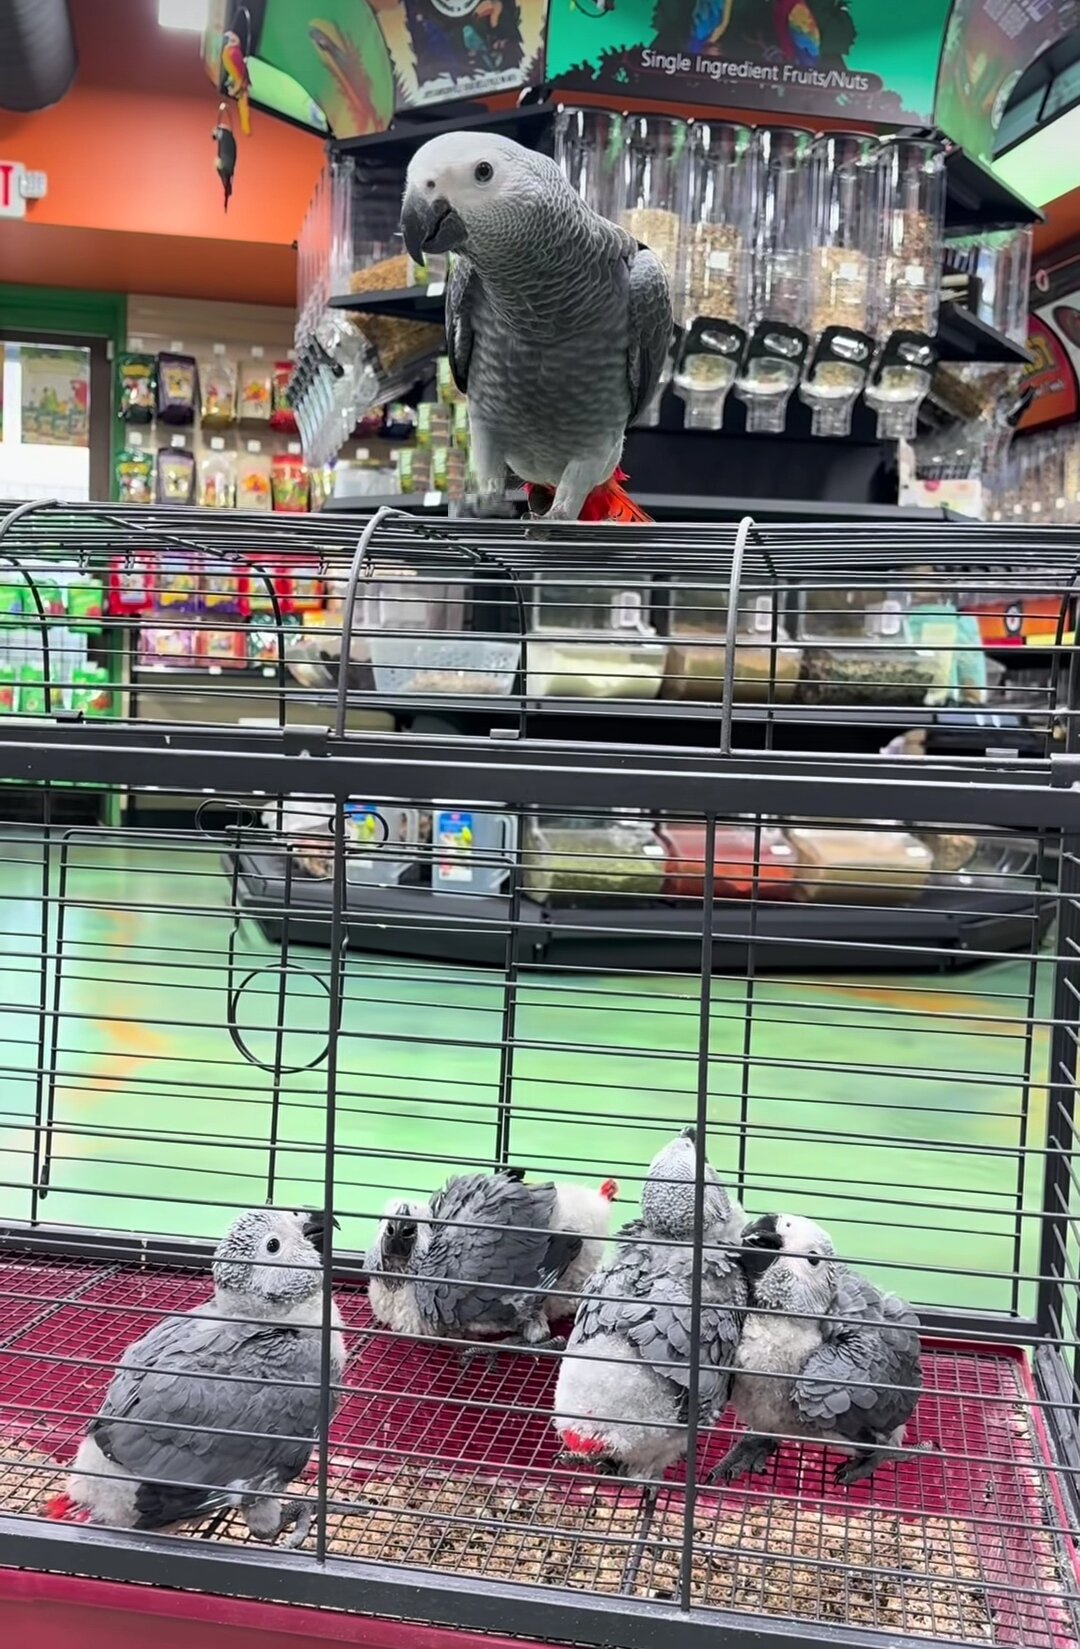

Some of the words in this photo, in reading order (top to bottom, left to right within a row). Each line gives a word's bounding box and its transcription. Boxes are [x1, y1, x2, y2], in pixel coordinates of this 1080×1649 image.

[641, 50, 690, 74] Single
[696, 56, 778, 80] Ingredient
[783, 66, 869, 90] Fruits/Nuts
